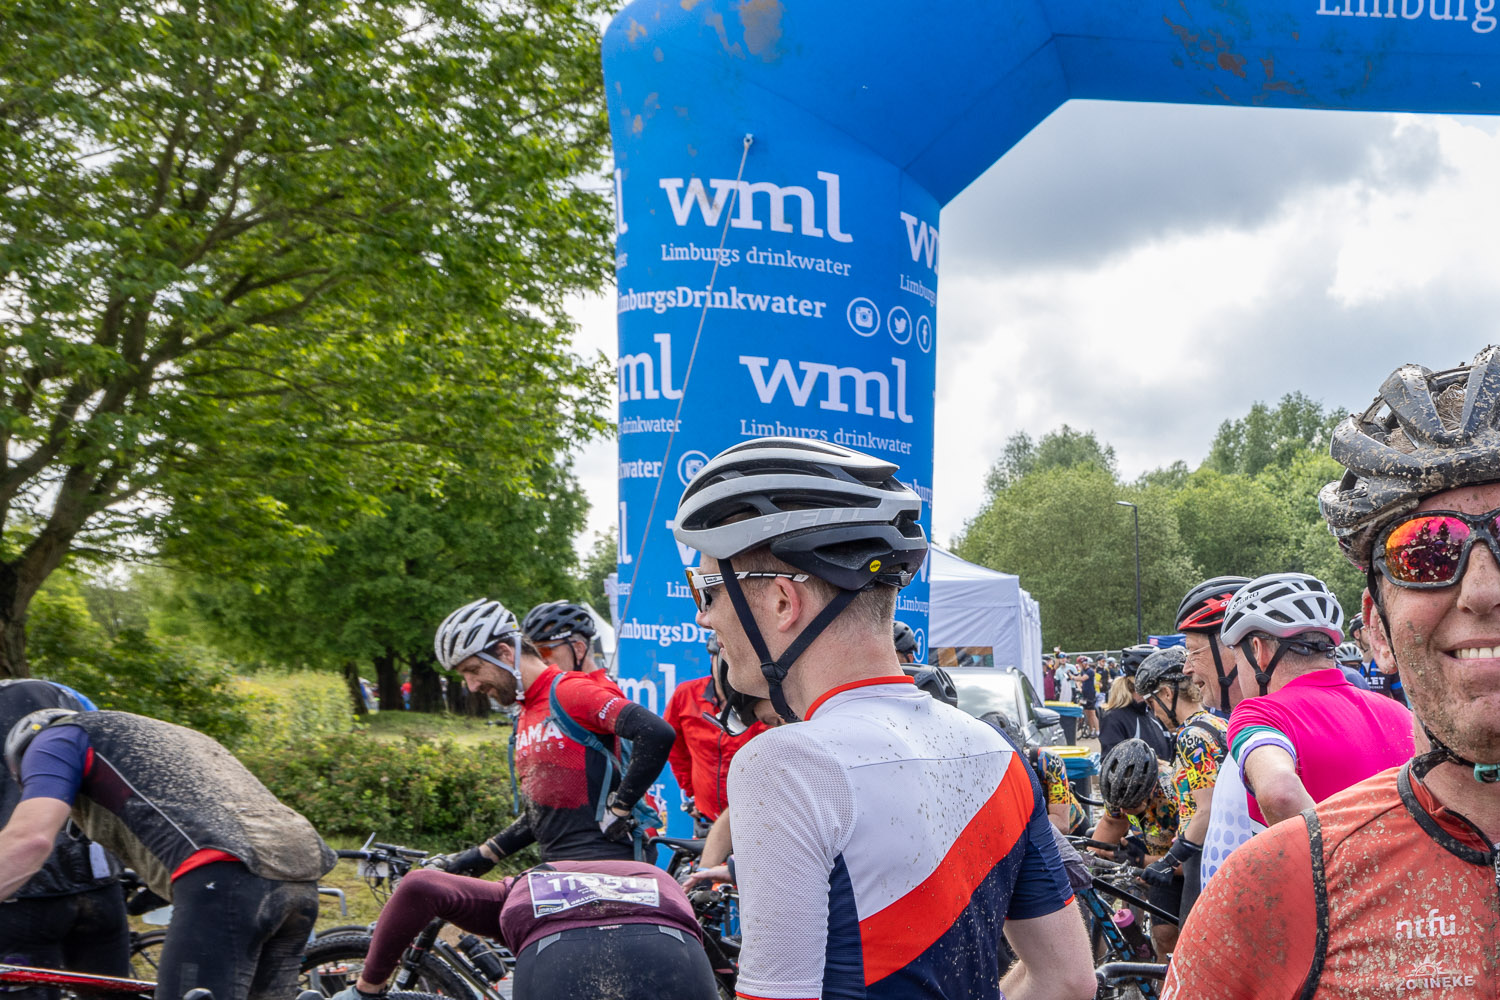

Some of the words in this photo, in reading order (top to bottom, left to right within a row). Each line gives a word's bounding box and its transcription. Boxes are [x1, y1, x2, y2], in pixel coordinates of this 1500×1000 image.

[659, 171, 853, 243] wml
[661, 243, 740, 267] Limburgs
[746, 246, 851, 276] drinkwater
[618, 333, 683, 402] ml
[739, 355, 913, 423] wml
[834, 428, 912, 455] drinkwater
[617, 664, 676, 715] ml
[1395, 908, 1457, 940] ntfu
